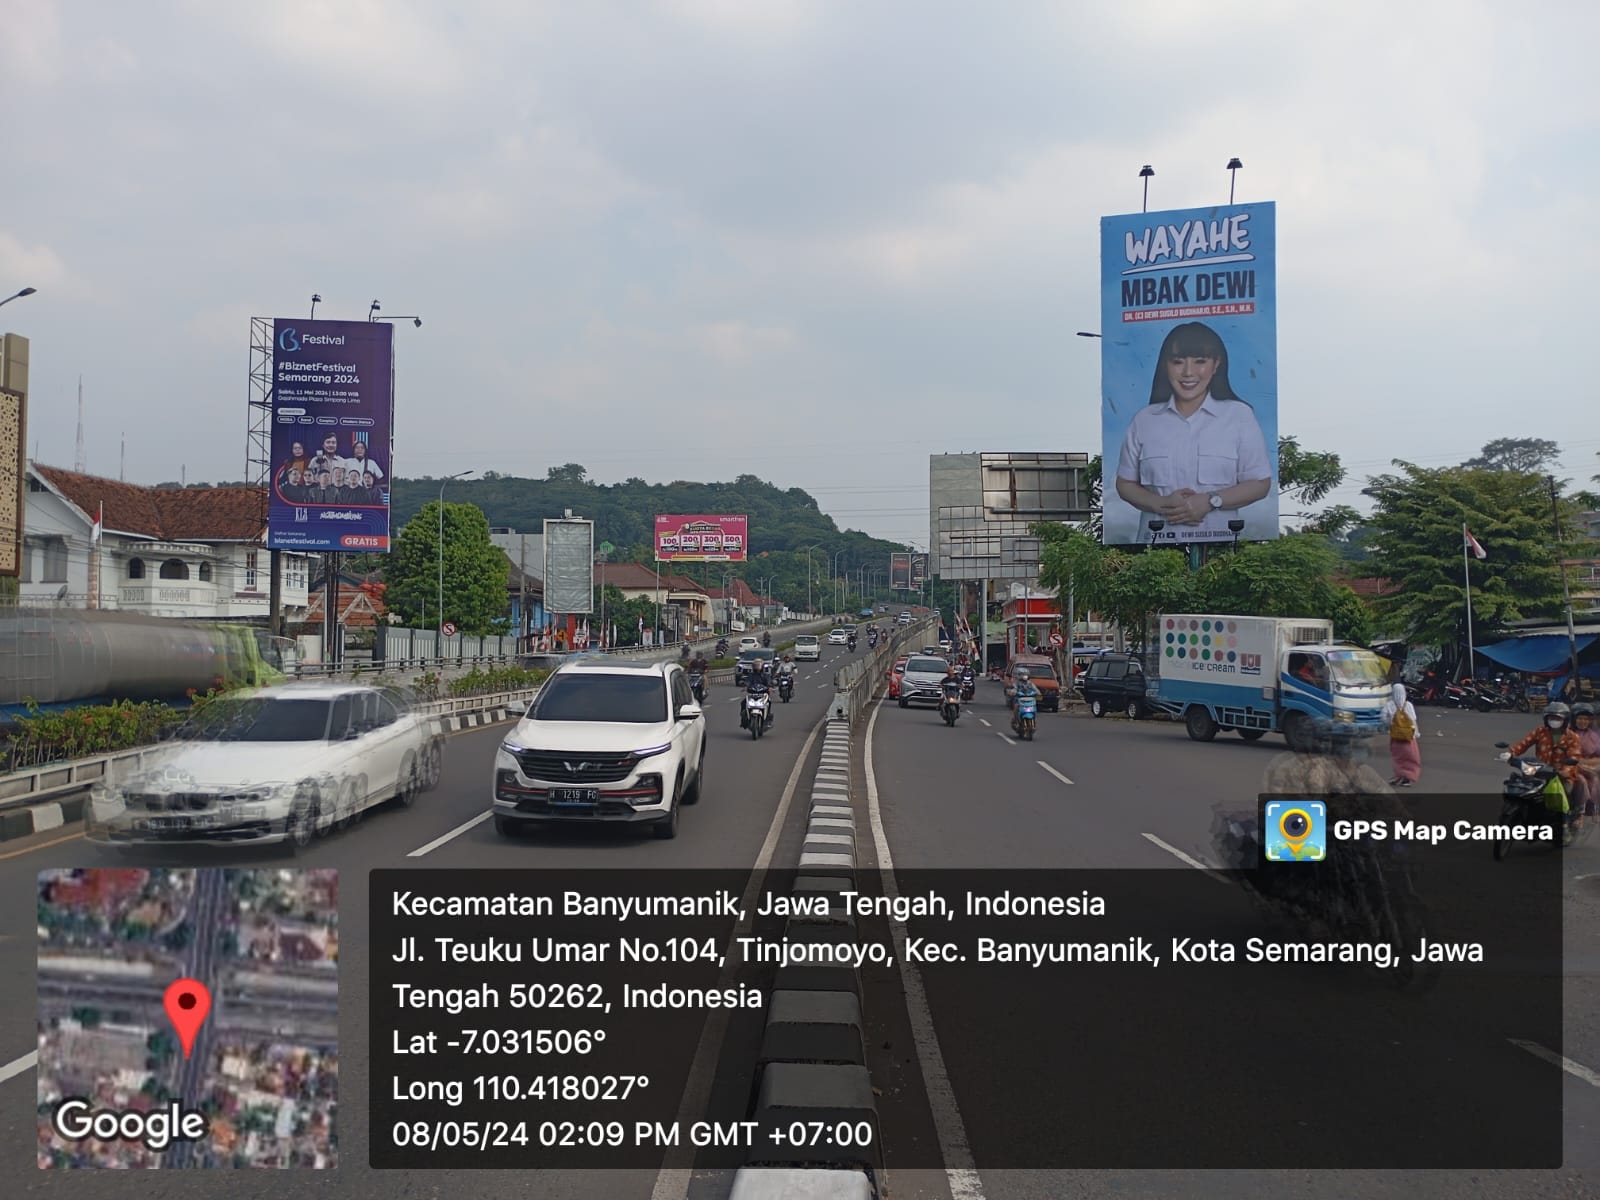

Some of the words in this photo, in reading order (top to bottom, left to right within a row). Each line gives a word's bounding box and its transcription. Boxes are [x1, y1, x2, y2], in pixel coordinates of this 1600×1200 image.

[1125, 213, 1250, 265] WAYAHE
[1121, 275, 1189, 307] MBAK
[1196, 269, 1255, 301] DEWI
[1144, 311, 1159, 319] DEWI
[302, 334, 345, 345] Festival
[278, 362, 356, 373] #BiznetFestival
[278, 373, 332, 384] Semarang
[334, 374, 360, 384] 2024
[345, 537, 378, 546] GRATIS
